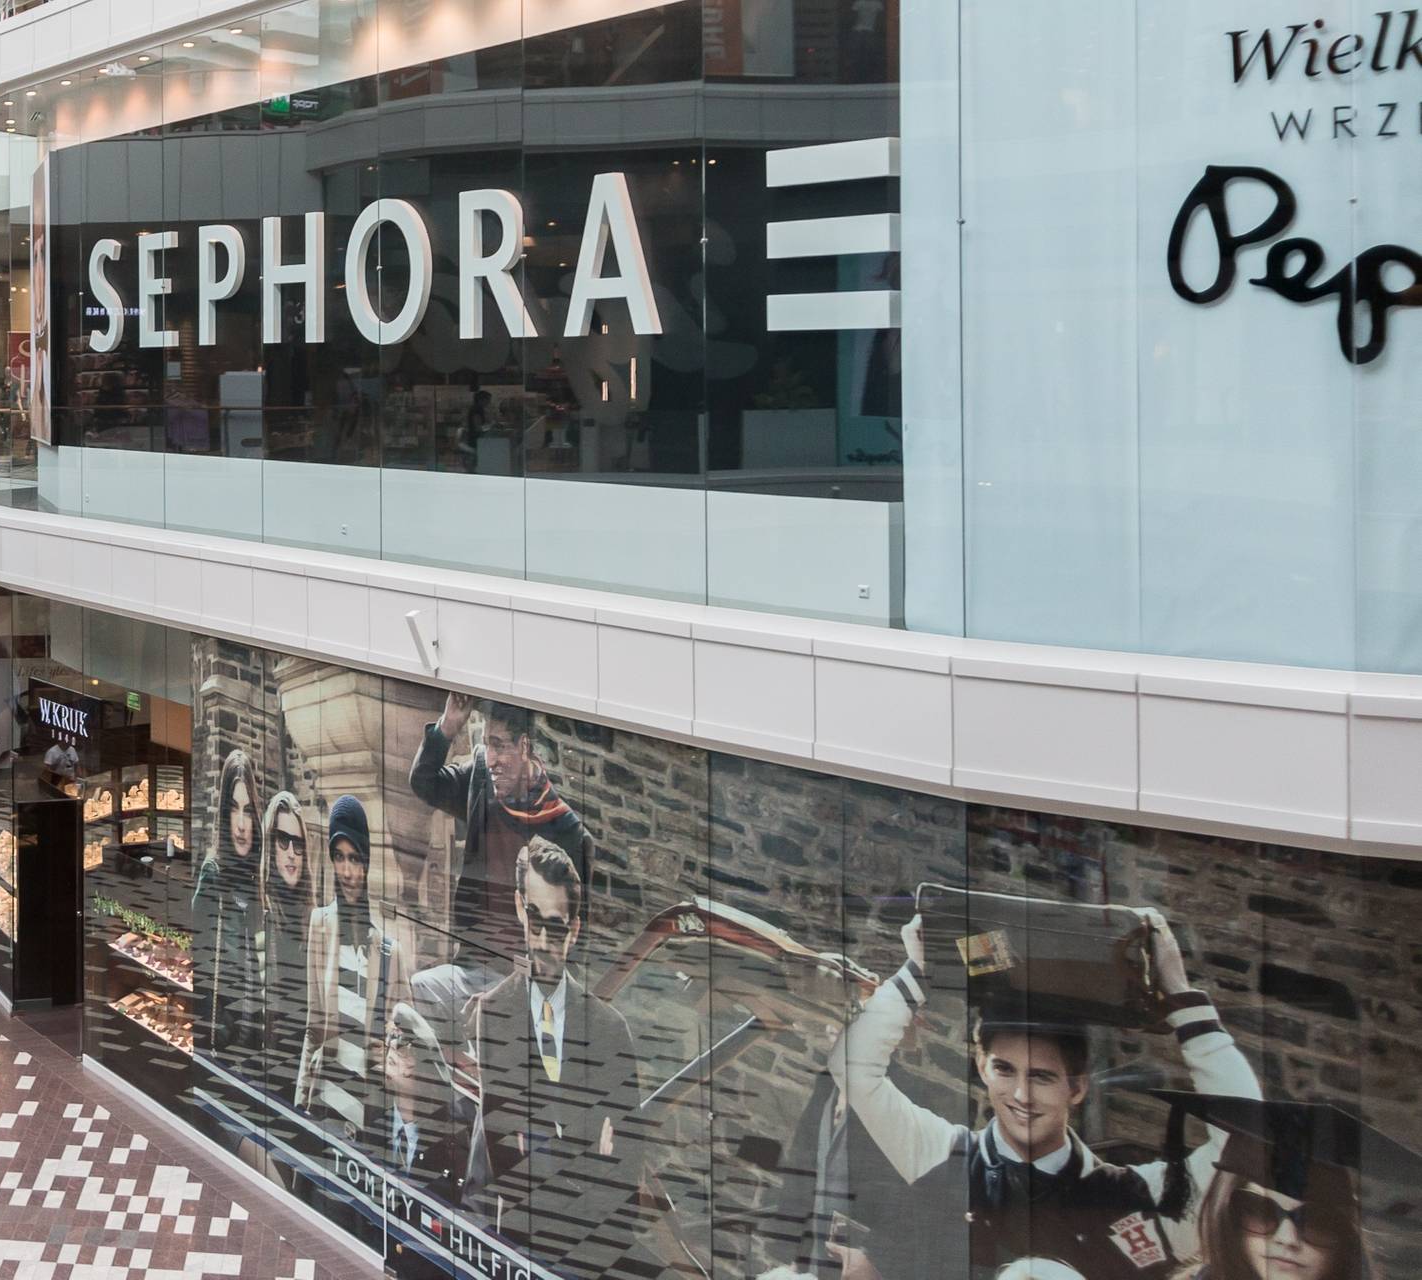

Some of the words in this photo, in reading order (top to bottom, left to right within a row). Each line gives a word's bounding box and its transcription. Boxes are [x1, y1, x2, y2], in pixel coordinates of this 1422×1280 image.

[1271, 103, 1422, 141] WRZ
[87, 172, 663, 353] SEPHORA
[332, 1148, 414, 1221] TOMMY
